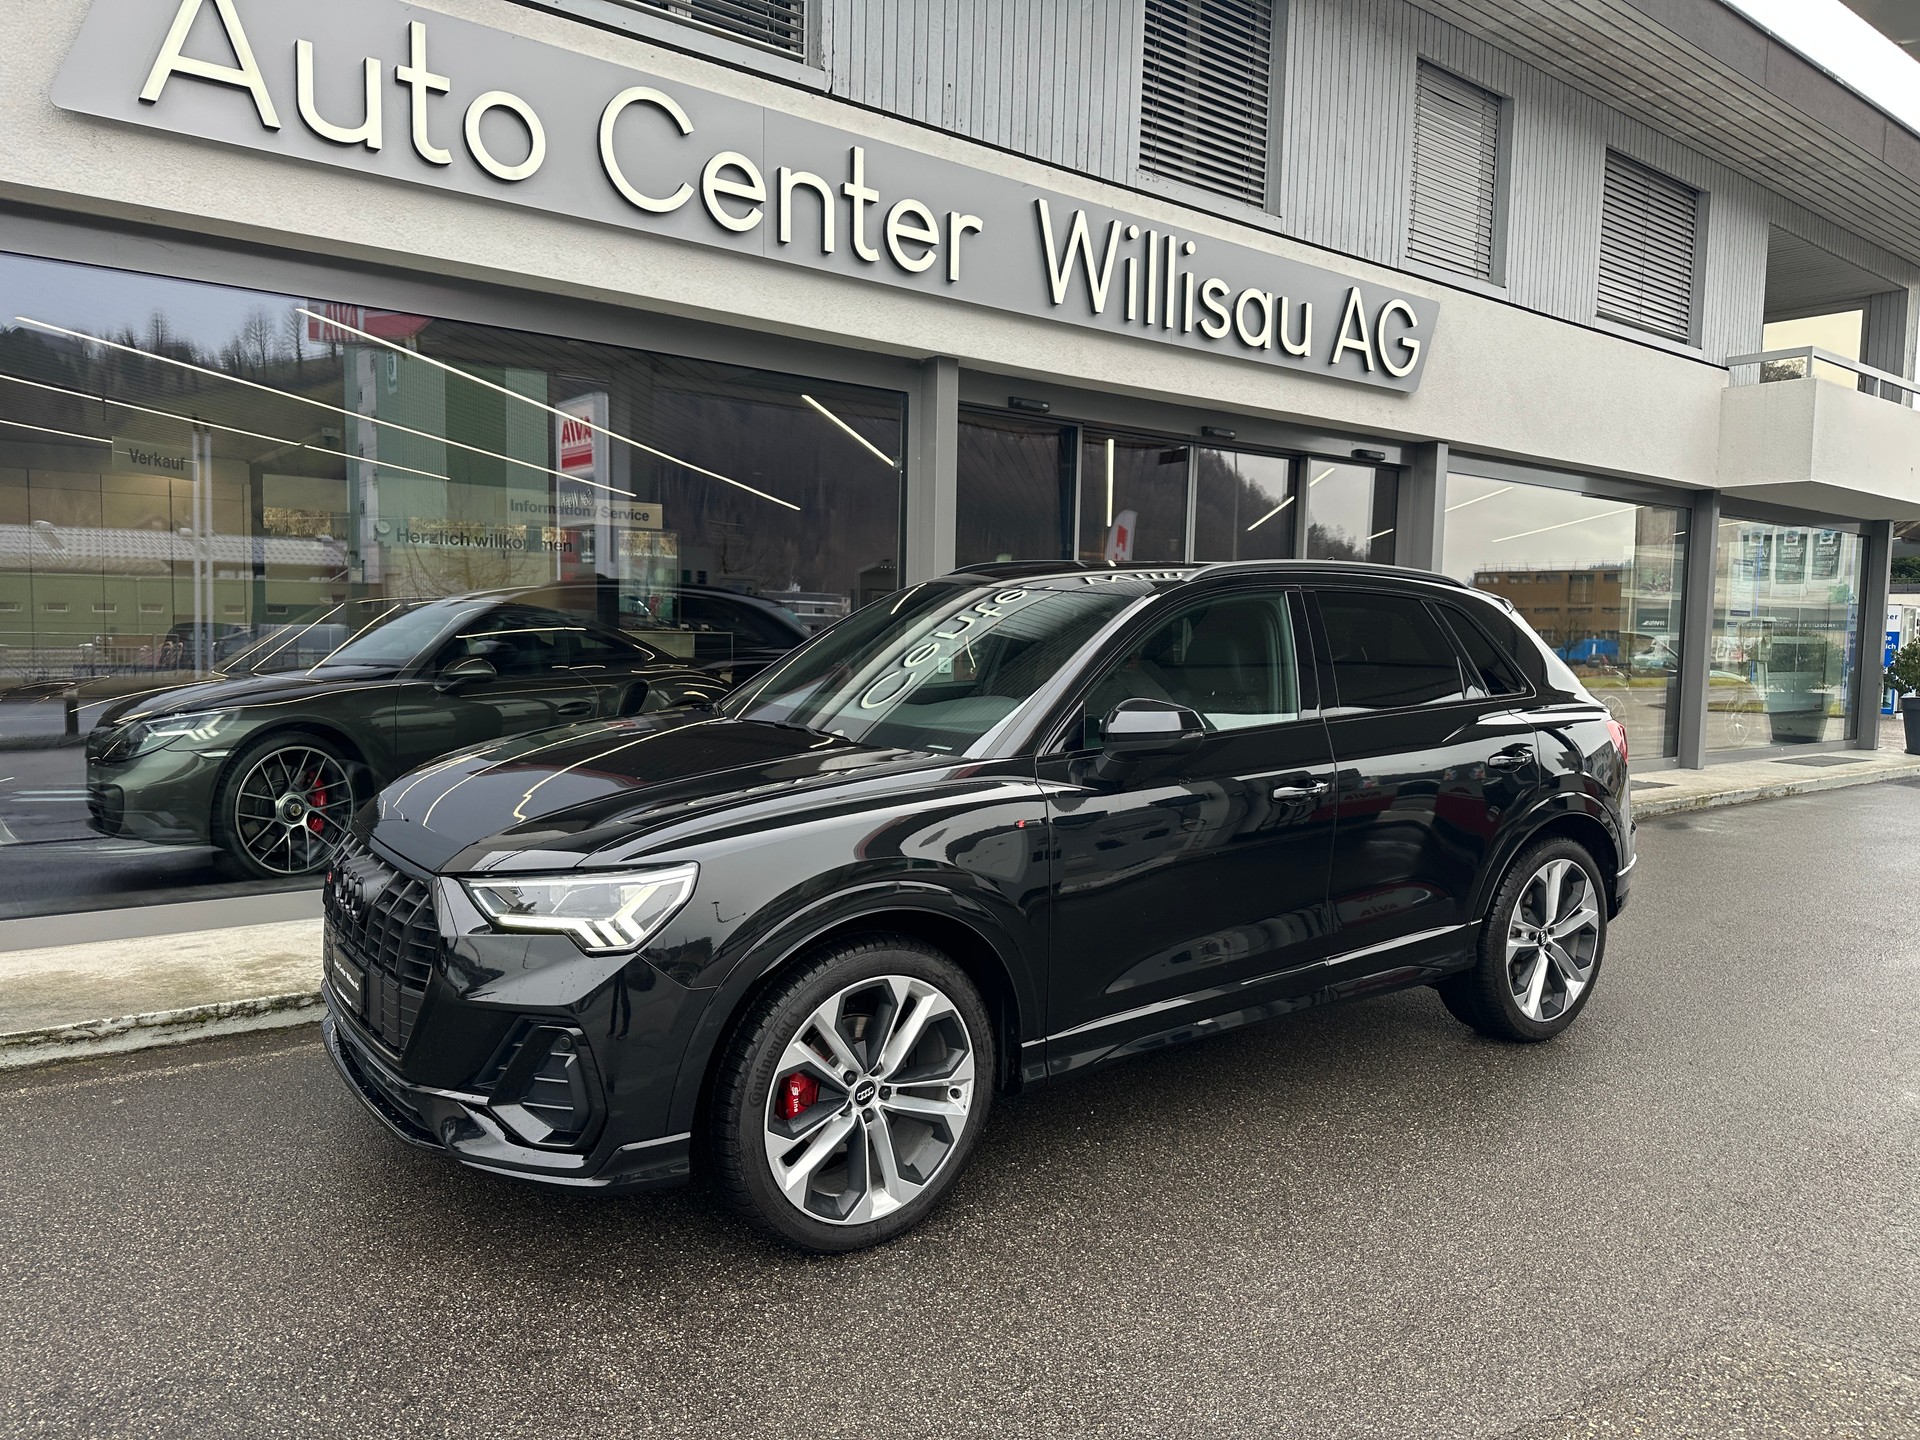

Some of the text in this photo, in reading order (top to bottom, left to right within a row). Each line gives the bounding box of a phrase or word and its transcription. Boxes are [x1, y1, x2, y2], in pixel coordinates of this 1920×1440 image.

[138, 0, 1421, 378] Auto Center Willisau AG
[128, 448, 187, 471] Verkauf
[510, 499, 591, 518] Information
[600, 505, 650, 522] Service
[396, 527, 573, 553] Herzlich willkomen
[748, 1020, 793, 1107] Continental
